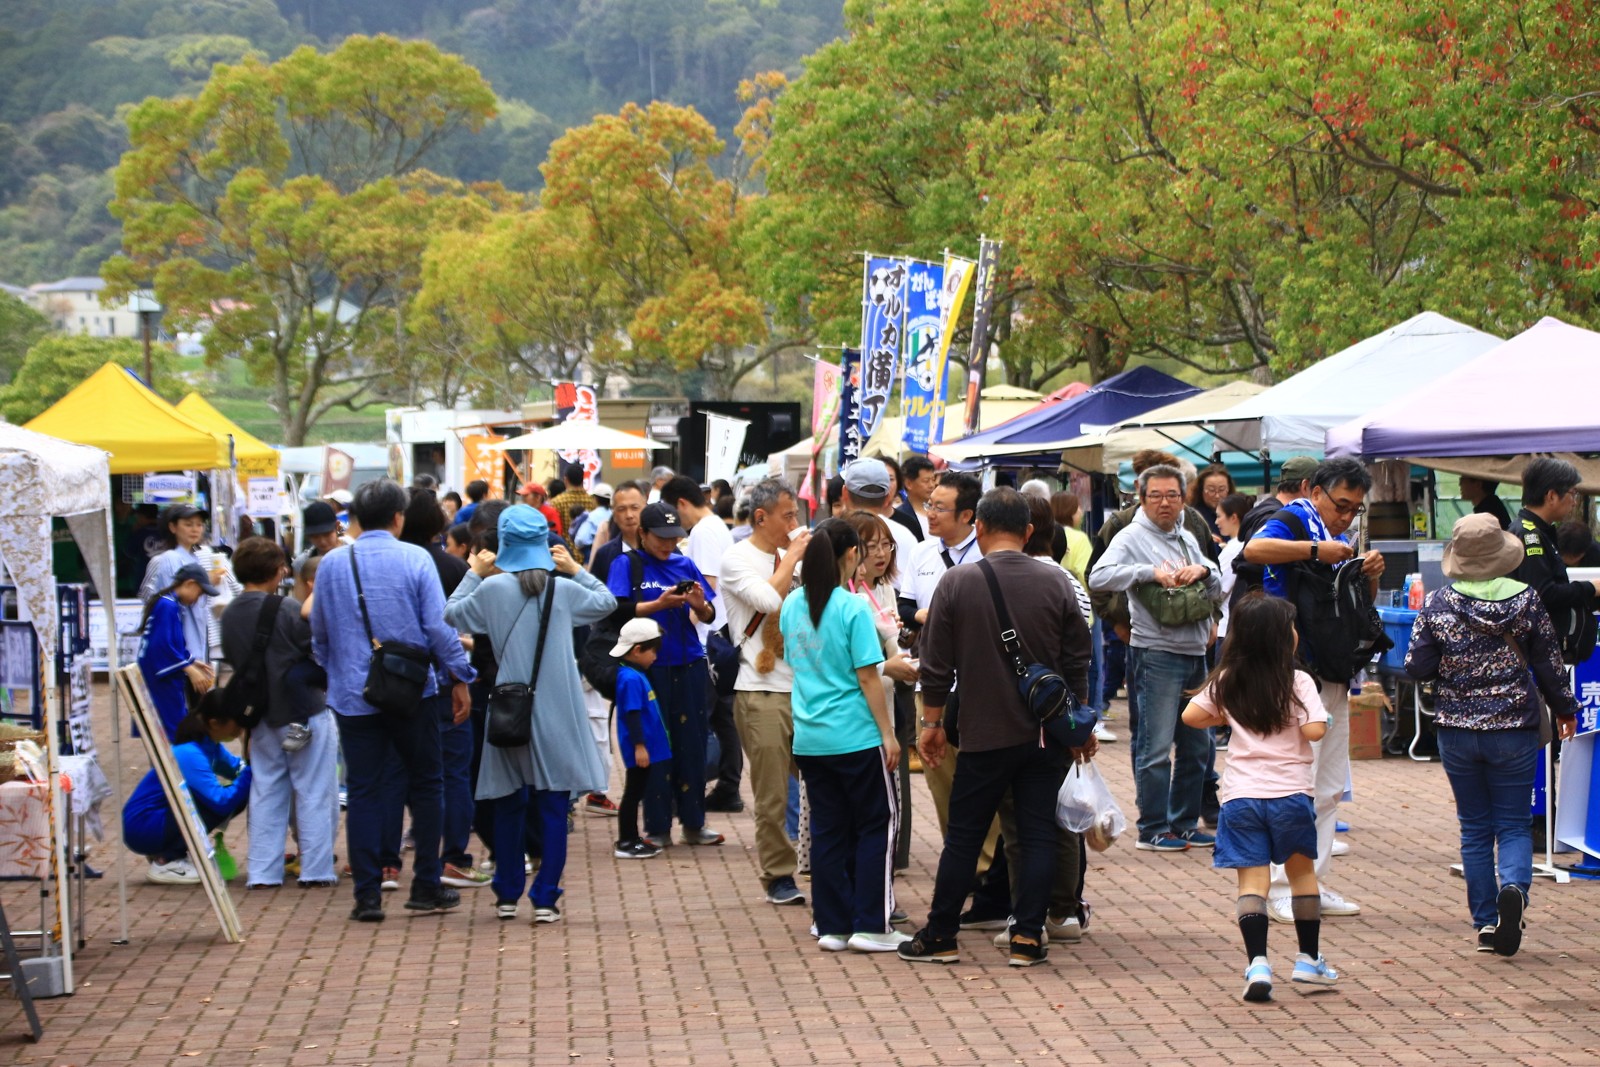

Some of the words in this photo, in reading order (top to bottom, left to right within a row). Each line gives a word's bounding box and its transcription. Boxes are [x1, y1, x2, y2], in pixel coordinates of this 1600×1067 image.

[910, 271, 935, 292] がん
[861, 264, 906, 433] オルカ横丁
